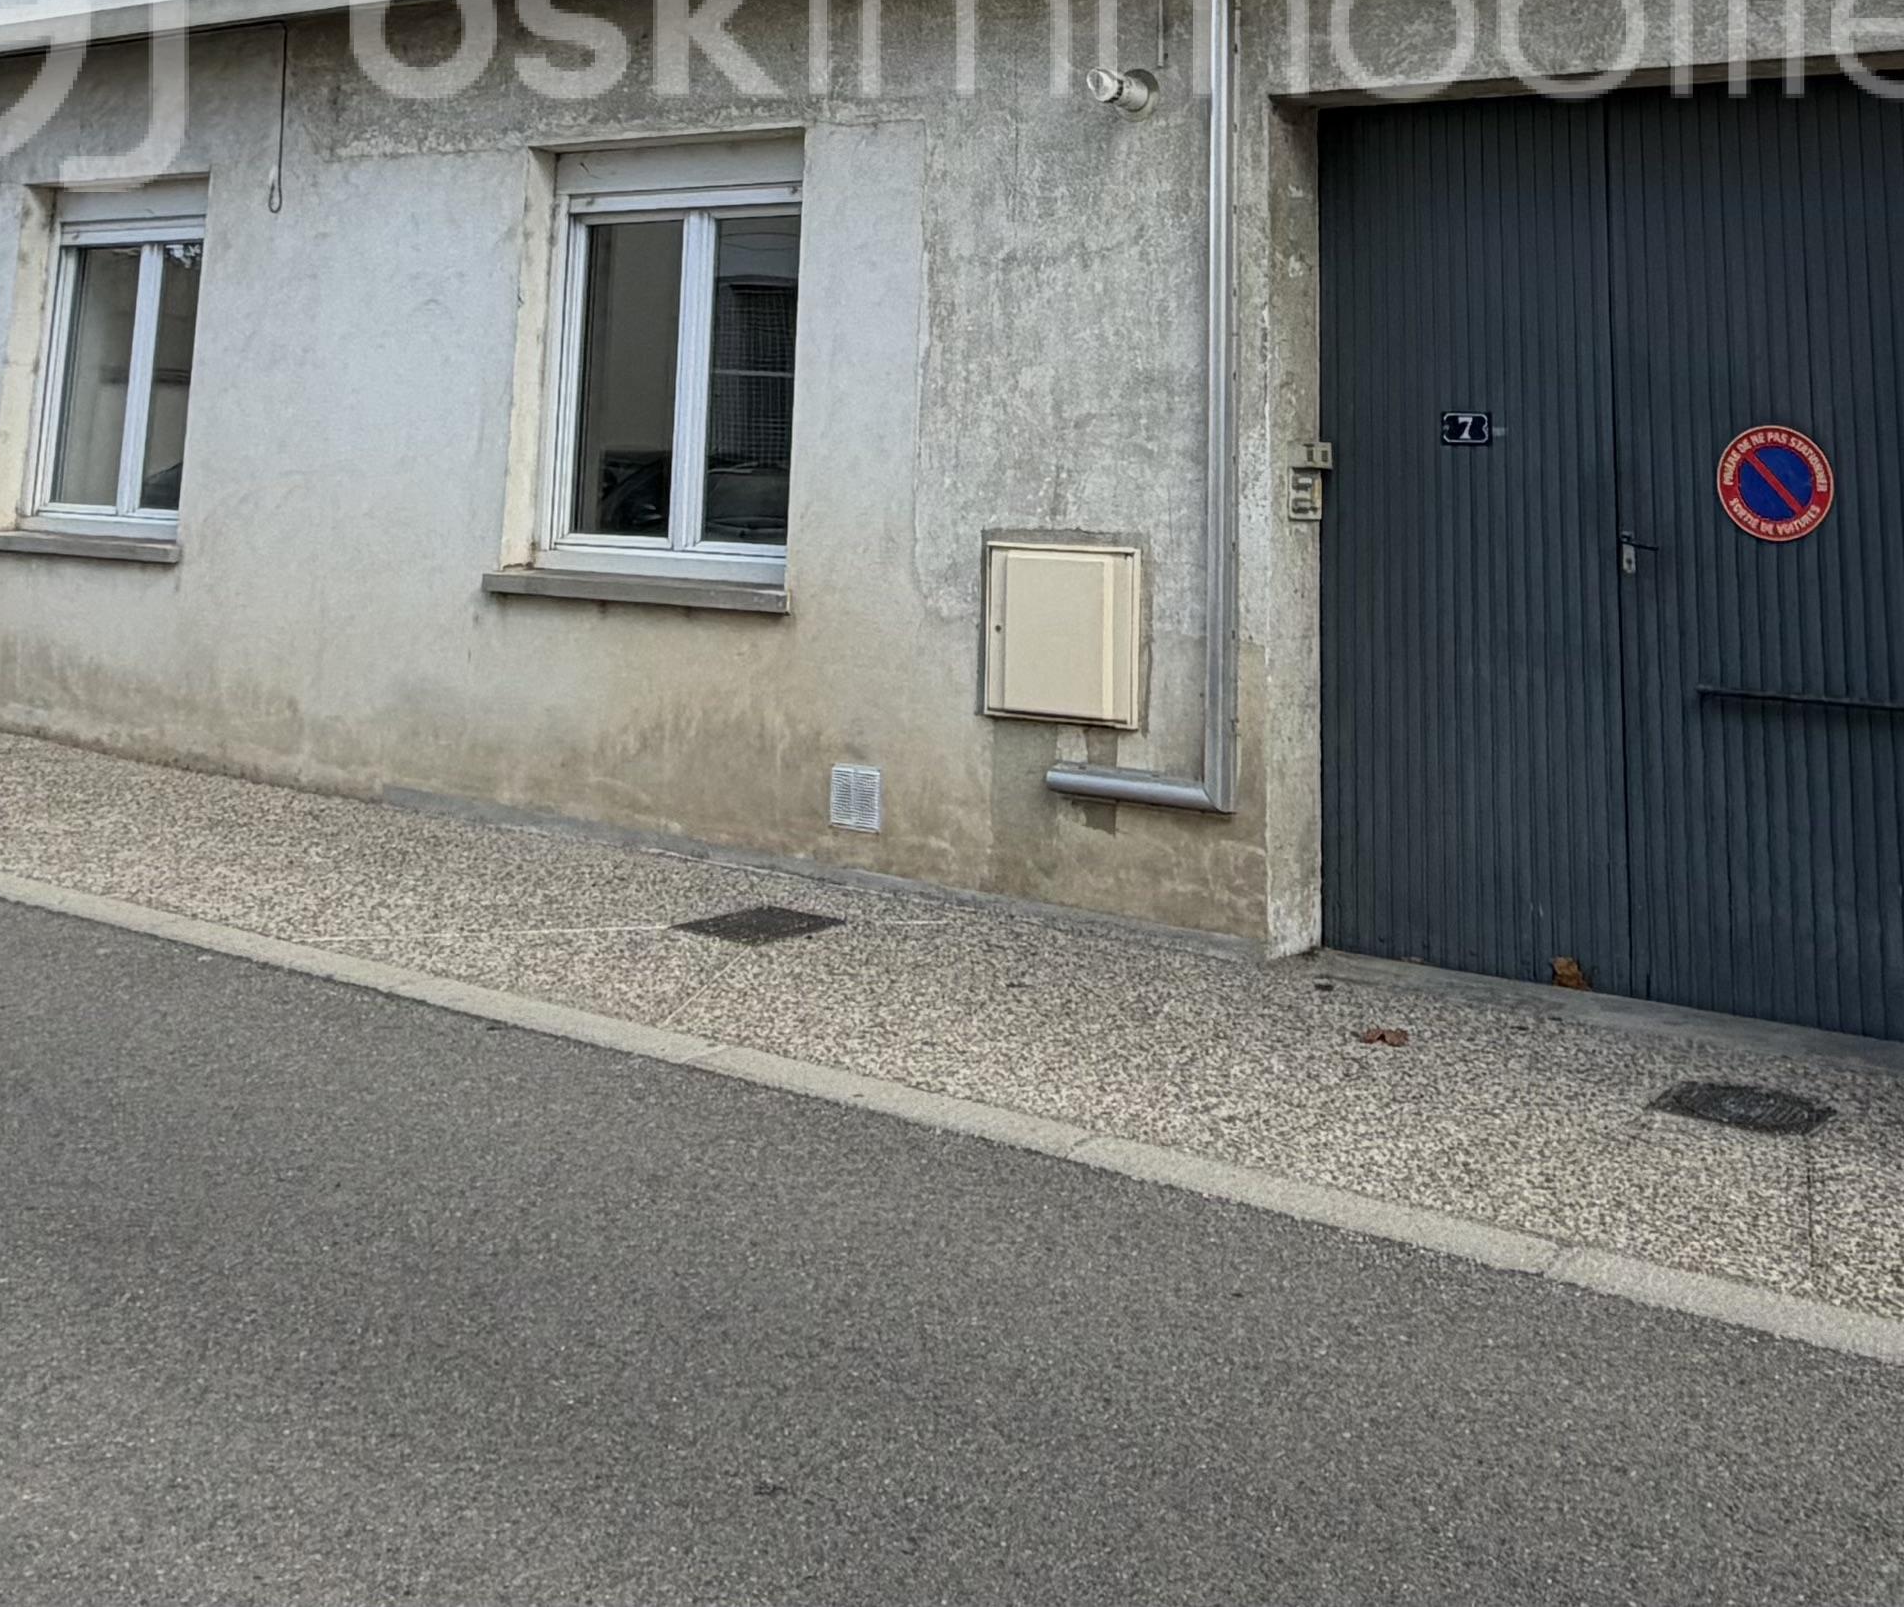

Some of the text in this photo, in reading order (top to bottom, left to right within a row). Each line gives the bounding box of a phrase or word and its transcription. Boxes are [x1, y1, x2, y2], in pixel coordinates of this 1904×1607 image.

[1458, 416, 1473, 439] 7
[1736, 438, 1752, 453] DE
[1750, 432, 1766, 445] NE
[1767, 431, 1789, 444] PAS
[1760, 522, 1775, 535] DE
